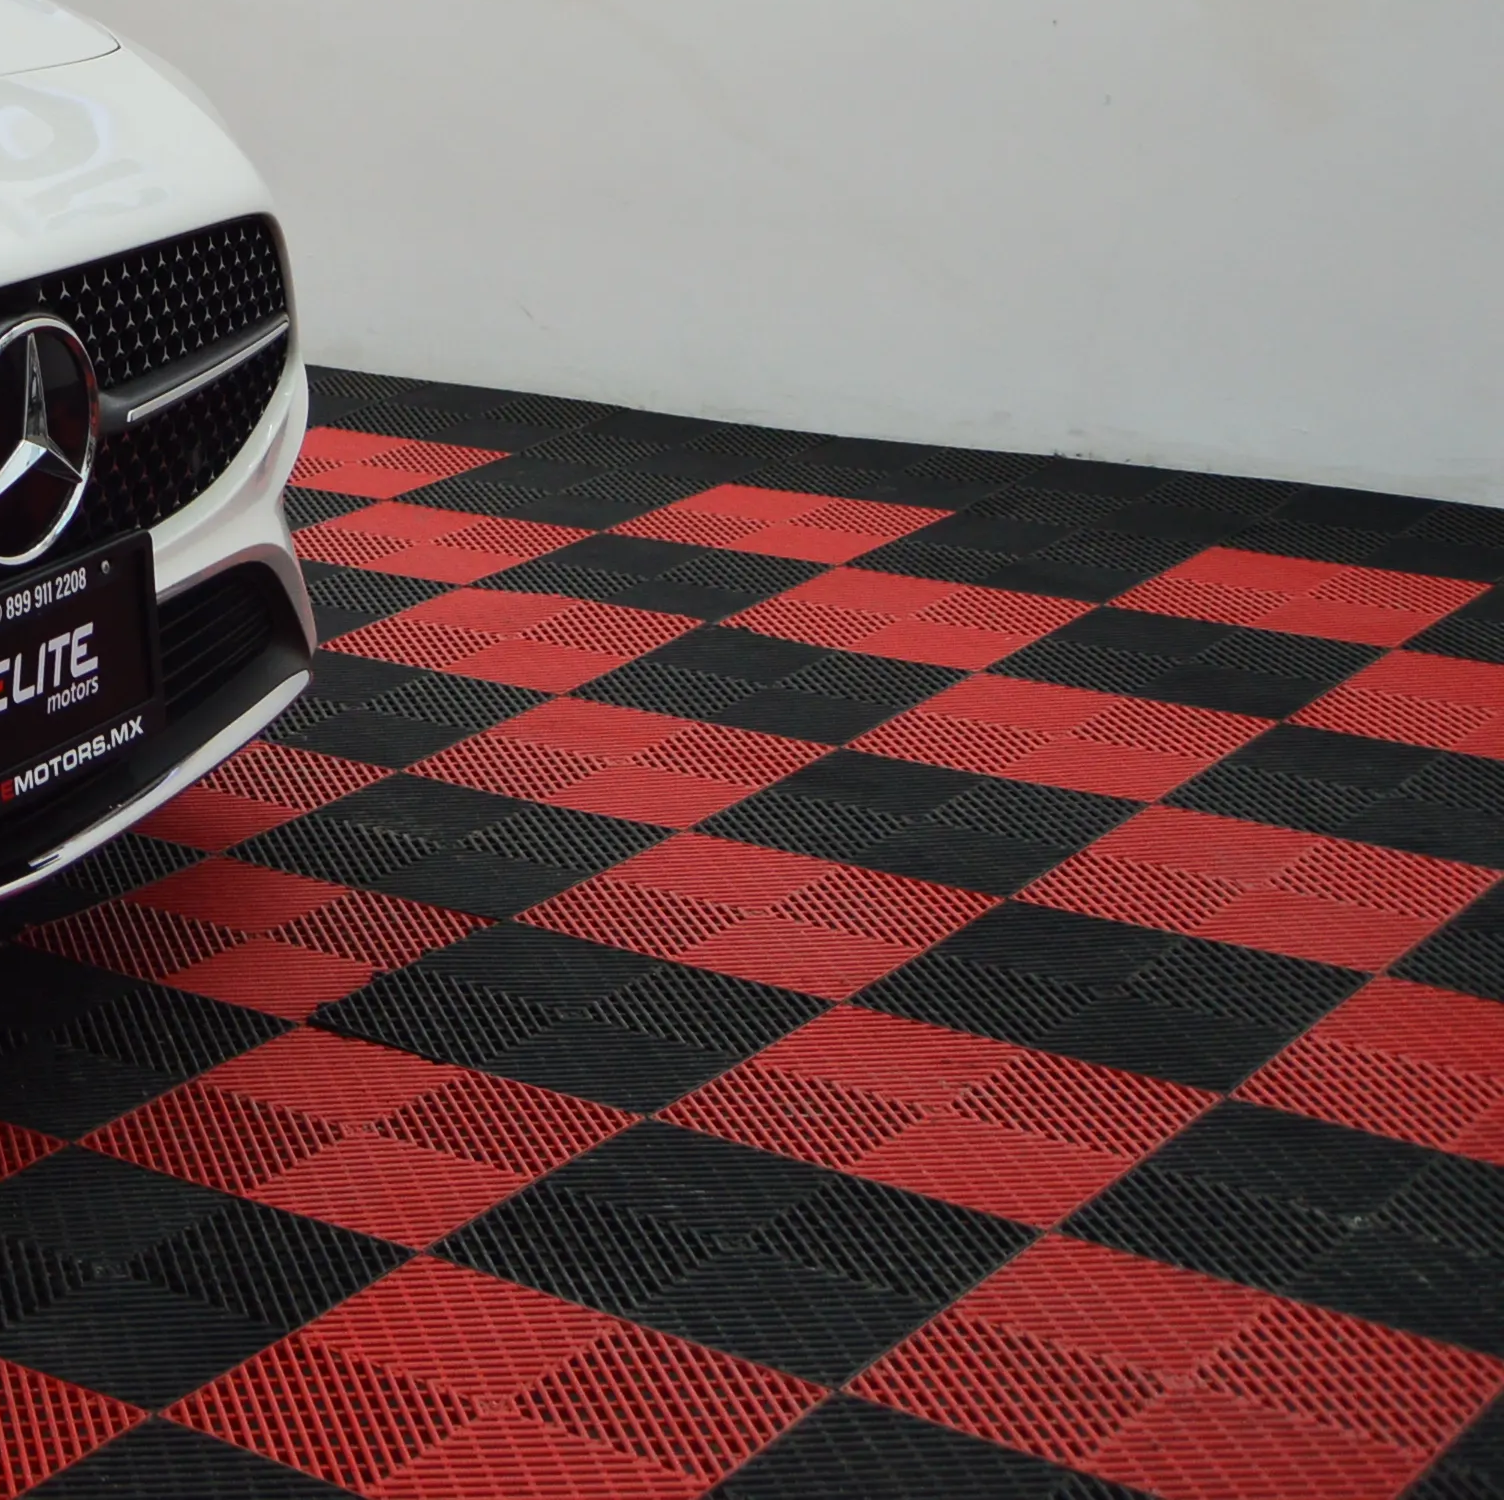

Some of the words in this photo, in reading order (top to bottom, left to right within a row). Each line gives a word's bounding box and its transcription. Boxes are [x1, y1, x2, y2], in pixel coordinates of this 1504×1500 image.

[5, 590, 31, 620] 899
[34, 581, 53, 609] 911
[55, 566, 87, 600] 2208
[46, 675, 99, 715] motors
